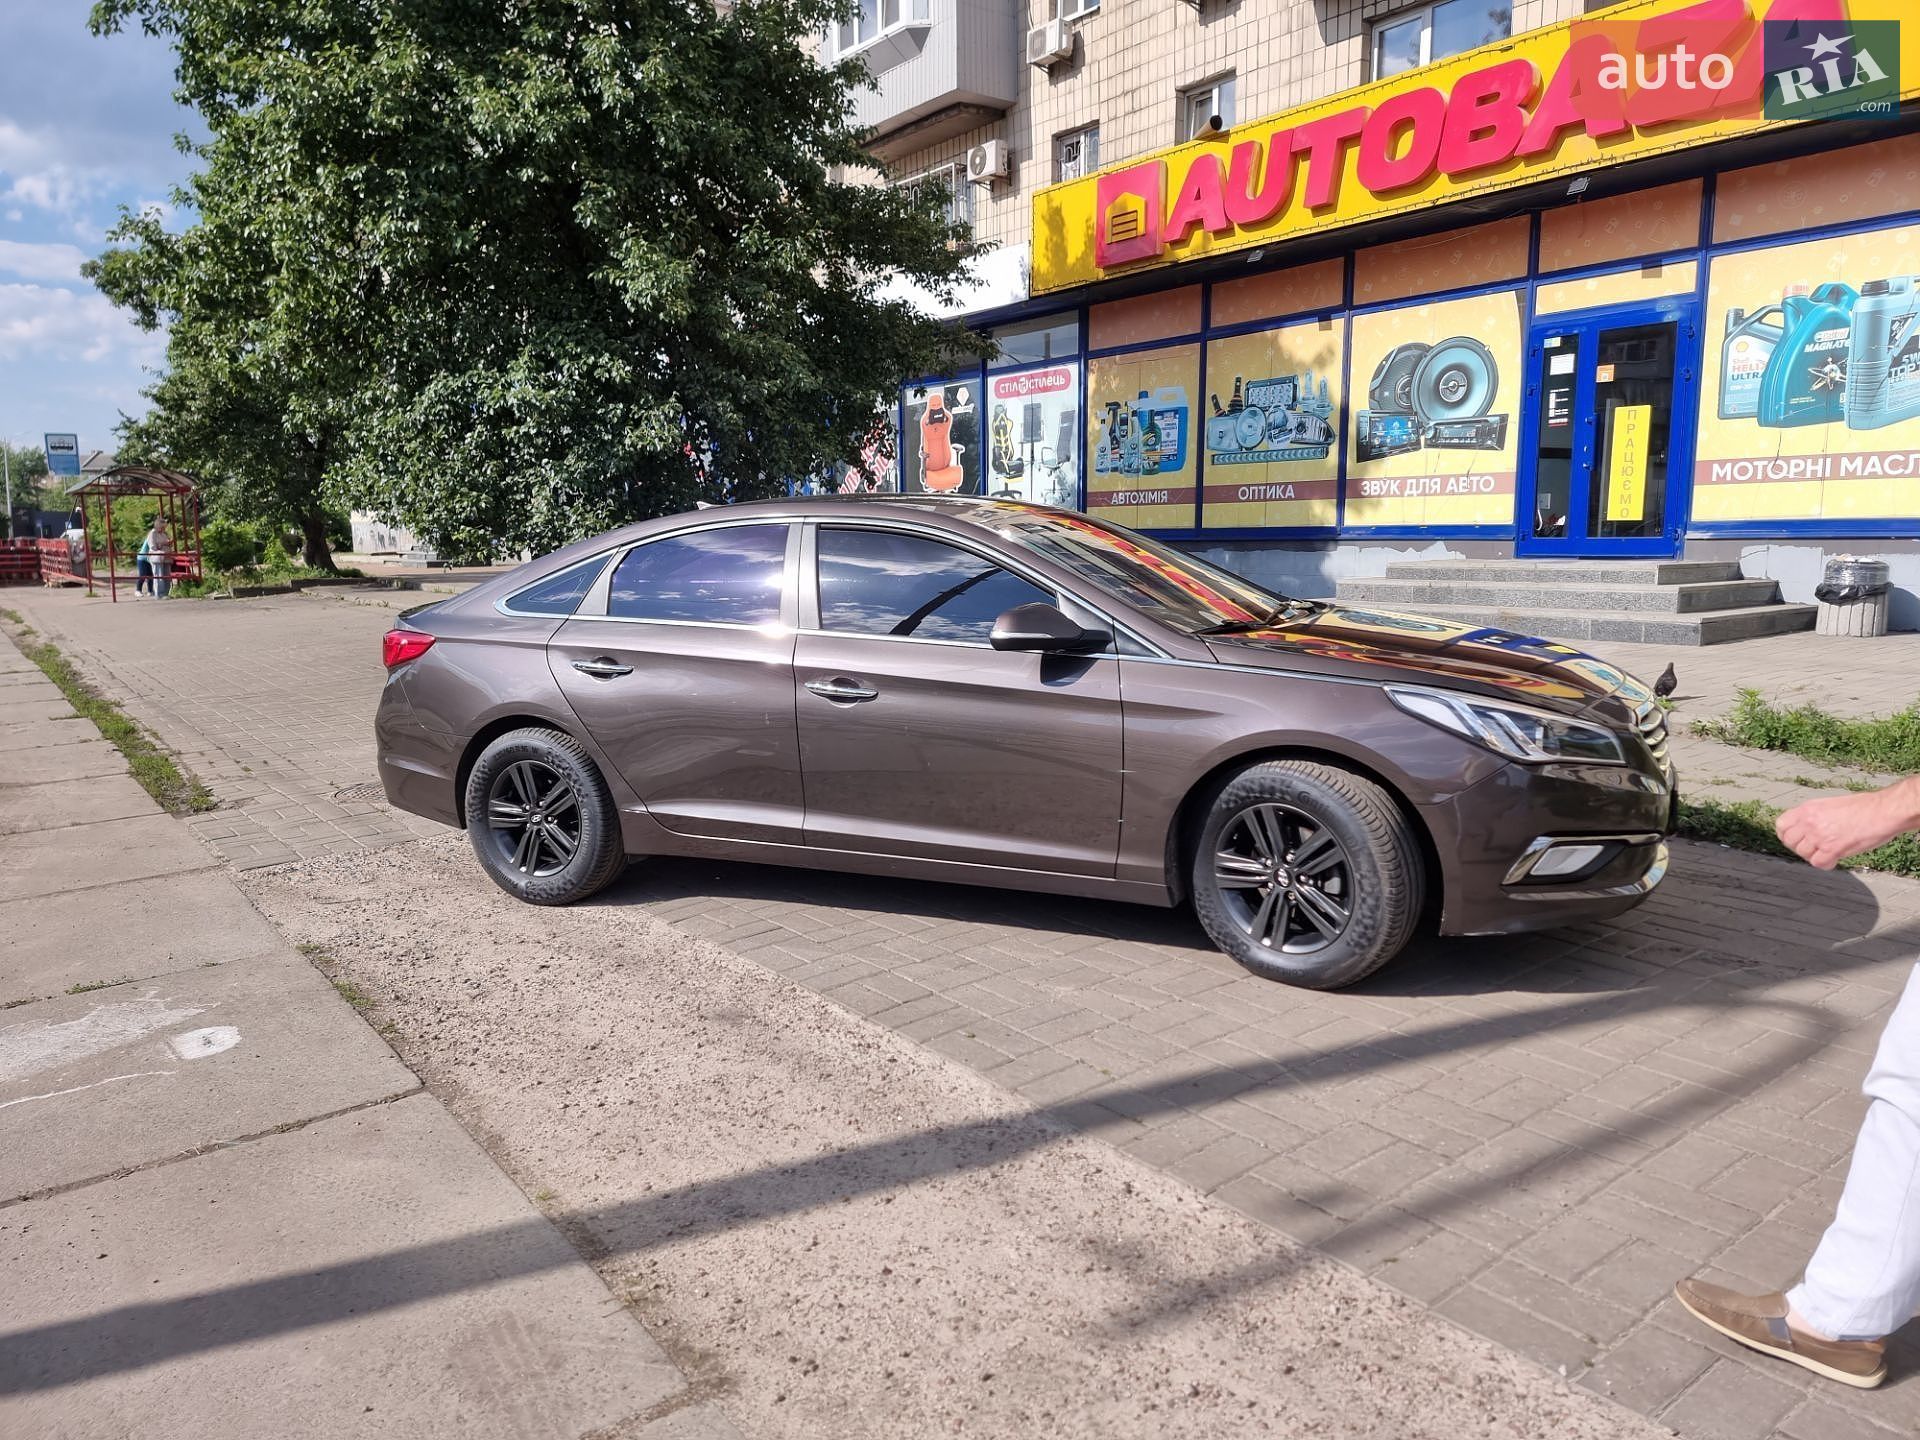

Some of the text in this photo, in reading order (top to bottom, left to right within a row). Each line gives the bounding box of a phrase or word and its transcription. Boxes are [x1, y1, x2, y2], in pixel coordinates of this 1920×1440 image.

[1164, 0, 1855, 244] AUTOBAZA
[1731, 371, 1762, 381] ULTR
[1619, 409, 1638, 519] ПРАЦЮЄМО
[1711, 453, 1920, 482] МОТОРНІ МАСЛ
[1238, 483, 1295, 501] ОПТИКА
[1361, 476, 1495, 497] ЗВУК ДЛЯ АВТО
[1111, 490, 1168, 505] АВТОХІМІЯ
